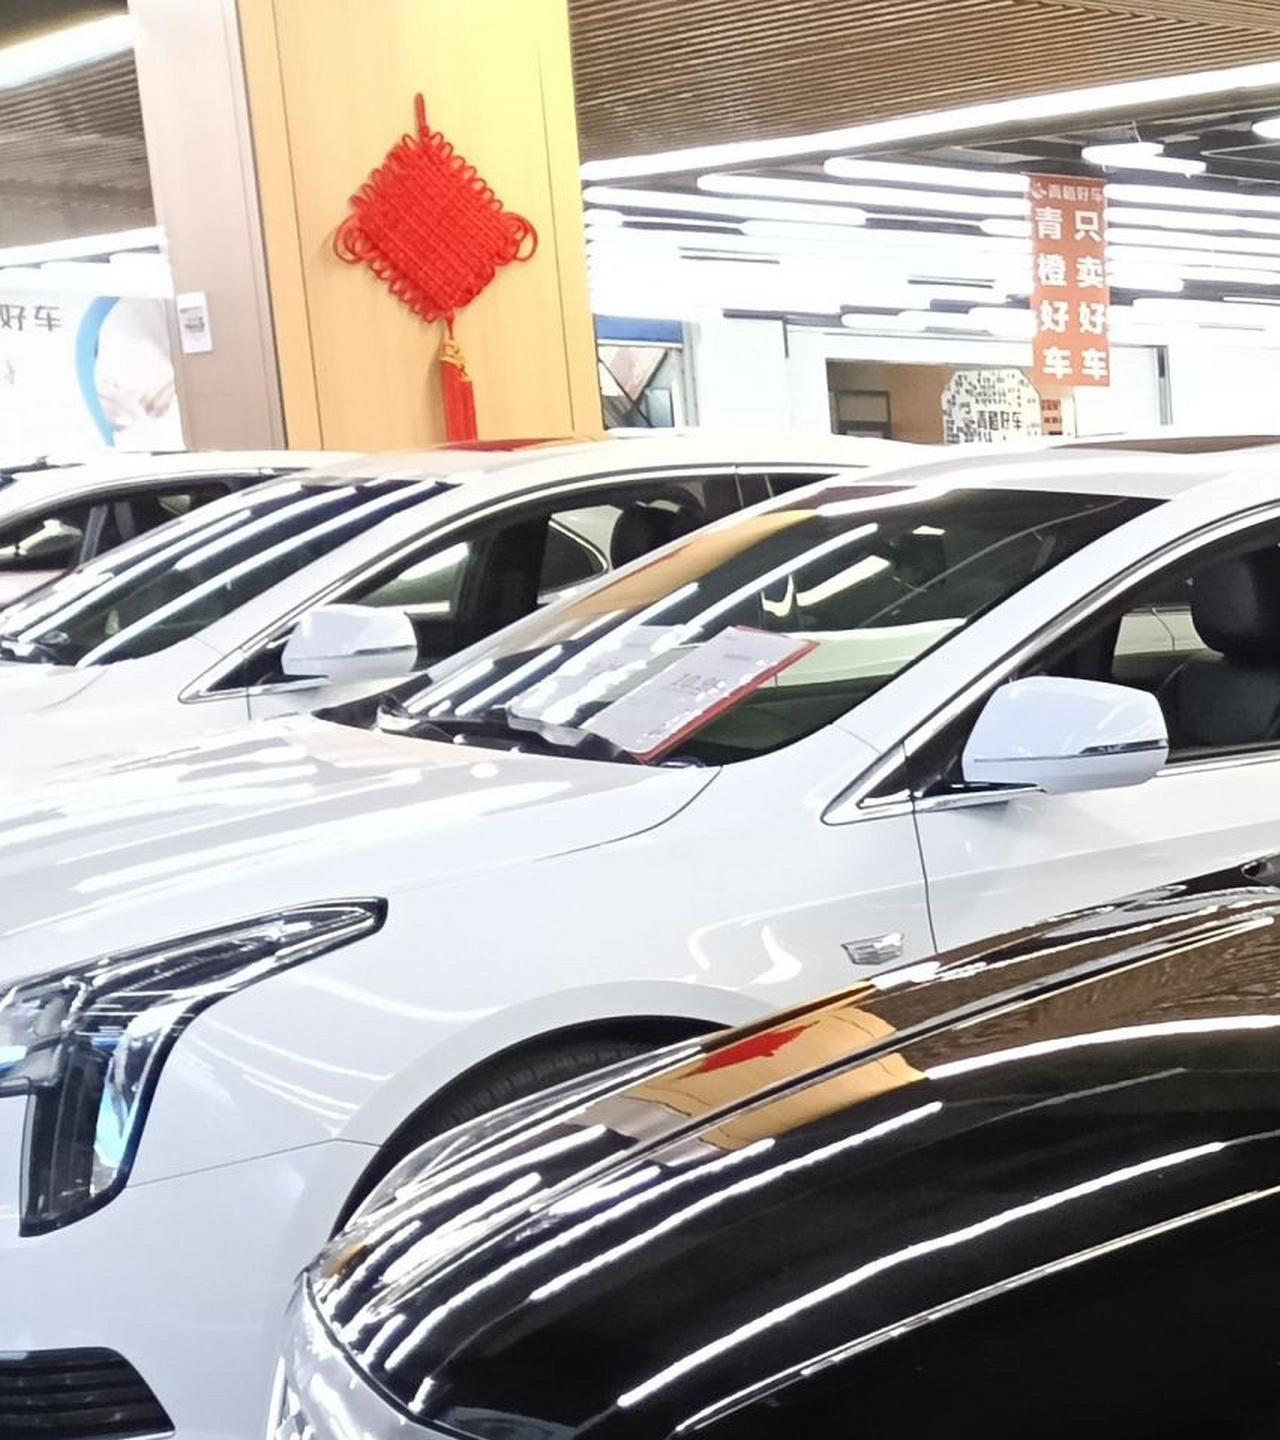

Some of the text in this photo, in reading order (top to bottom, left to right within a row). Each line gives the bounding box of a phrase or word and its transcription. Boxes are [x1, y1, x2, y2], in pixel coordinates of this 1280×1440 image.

[0, 304, 61, 332] 好车
[1035, 206, 1072, 379] 青橙好车
[1074, 210, 1109, 380] 只卖好车
